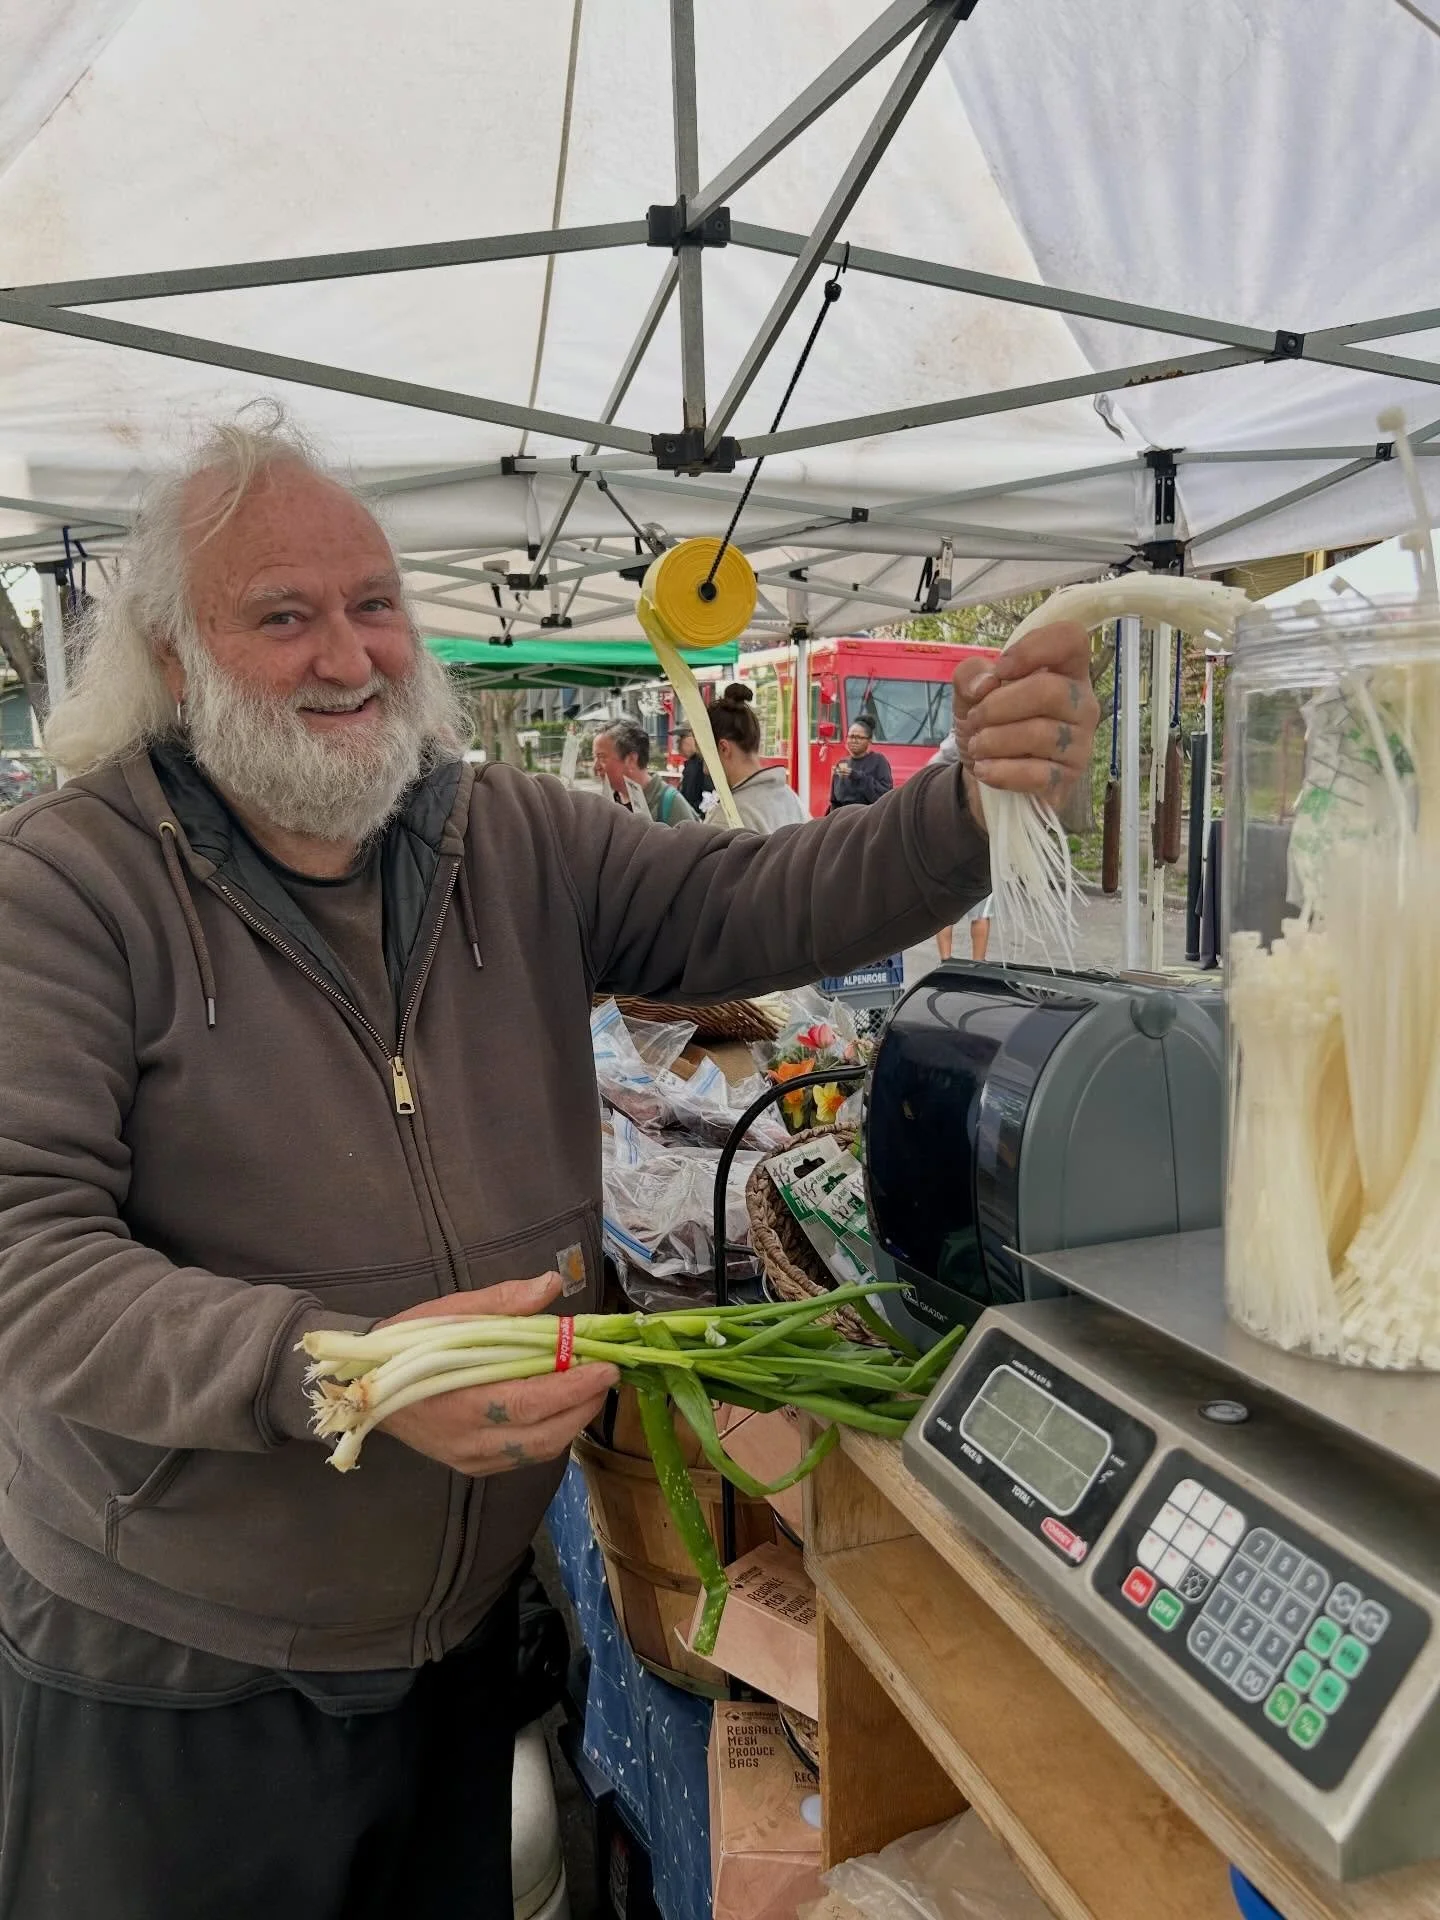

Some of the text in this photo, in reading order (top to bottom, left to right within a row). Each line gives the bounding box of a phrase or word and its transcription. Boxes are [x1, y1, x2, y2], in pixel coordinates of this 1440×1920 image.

[843, 972, 887, 986] ALPENROSE
[560, 1318, 571, 1362] egetable
[1253, 1540, 1317, 1591] 7 8 9
[1130, 1579, 1146, 1596] ON
[1235, 1570, 1248, 1584] 4
[1285, 1607, 1298, 1624] 6
[1155, 1599, 1176, 1617] OFF
[1218, 1600, 1280, 1653] 1 2 3
[1196, 1630, 1210, 1647] C
[1220, 1651, 1233, 1668] 0
[727, 1725, 781, 1736] REUSABLE
[727, 1736, 758, 1746] MESH
[728, 1747, 775, 1758] PRODUCE
[729, 1758, 759, 1769] BAGS
